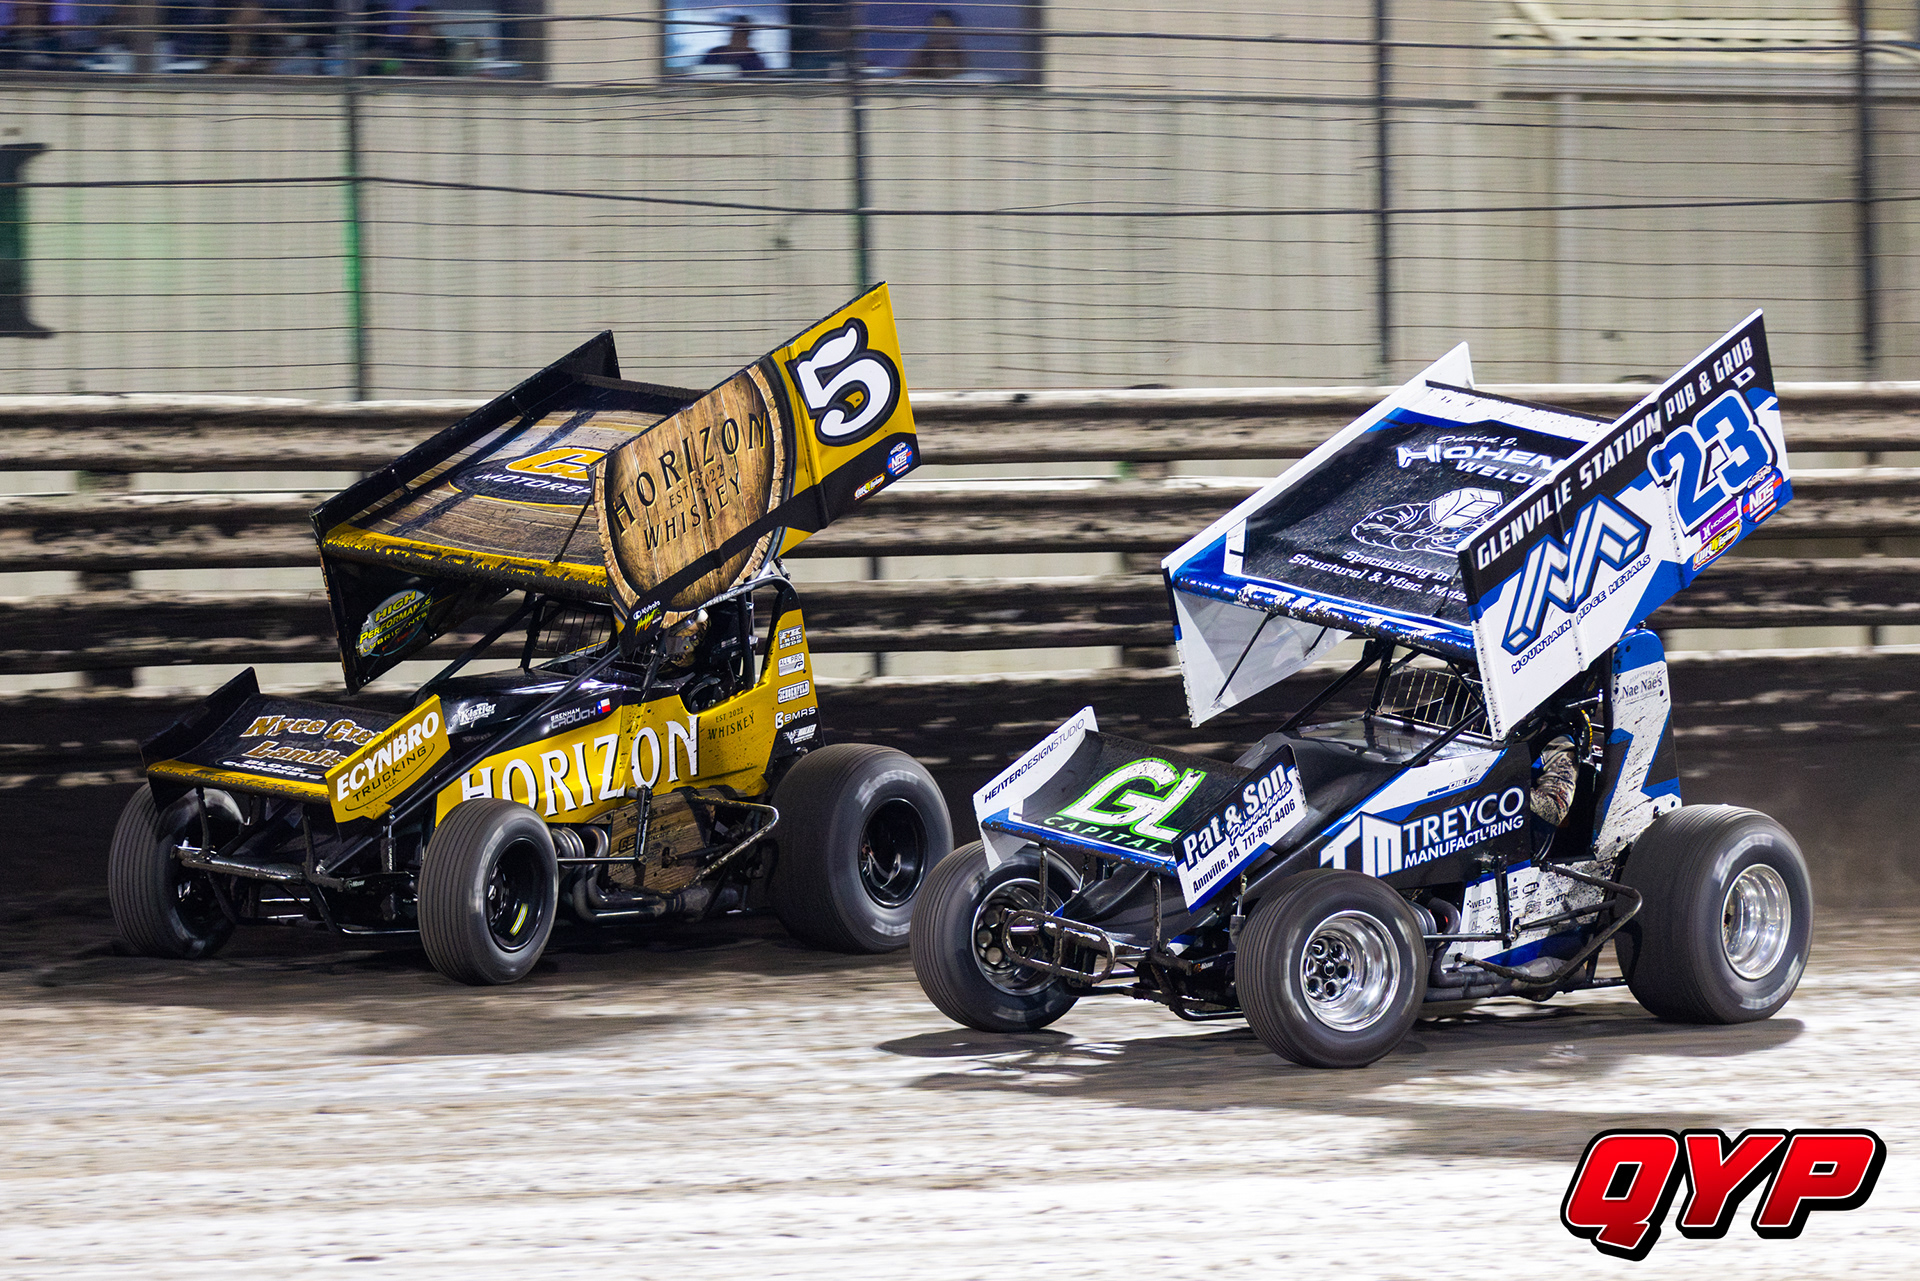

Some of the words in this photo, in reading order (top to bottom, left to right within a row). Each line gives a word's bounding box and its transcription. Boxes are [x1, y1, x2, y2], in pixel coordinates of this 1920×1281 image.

[786, 318, 900, 446] 5
[612, 411, 766, 537] HORIZON
[1477, 478, 1573, 571] GLENVILLE
[1578, 410, 1663, 491] STATION
[1665, 391, 1697, 421] PUB
[1698, 371, 1712, 395] &
[1713, 336, 1754, 382] GRUB
[1647, 389, 1776, 534] 23
[643, 472, 741, 551] WHISKEY
[669, 485, 690, 509] EST
[1749, 473, 1776, 512] NOS
[1289, 553, 1369, 579] Structural
[1368, 571, 1384, 584] &
[1383, 574, 1423, 593] Misc.
[375, 590, 417, 622] HIGH
[1511, 619, 1572, 674] MOUNTAIN
[1576, 590, 1608, 625] RIDGE
[1608, 554, 1652, 595] METALS
[323, 718, 384, 746] Cre
[460, 703, 496, 725] Kistler
[550, 707, 581, 722] BRENHAM
[550, 707, 597, 730] CROUCH
[707, 710, 755, 741] WHISKEY
[715, 713, 727, 724] EST
[729, 706, 744, 719] 2022
[337, 711, 439, 802] ECYNBRO
[352, 745, 427, 802] TRUCKING
[460, 714, 700, 818] HORIZON
[1043, 814, 1160, 853] CAPITAL
[1182, 815, 1224, 869] Pat
[1225, 804, 1243, 833] &
[1243, 763, 1287, 816] Son
[1402, 787, 1525, 851] TREYCO
[1404, 814, 1525, 870] MANUFACTURING
[1192, 858, 1229, 894] Annville,
[1228, 846, 1240, 863] PA
[1241, 798, 1297, 851] 717-867-4406
[1320, 813, 1402, 878] TM
[1471, 896, 1493, 909] WELD
